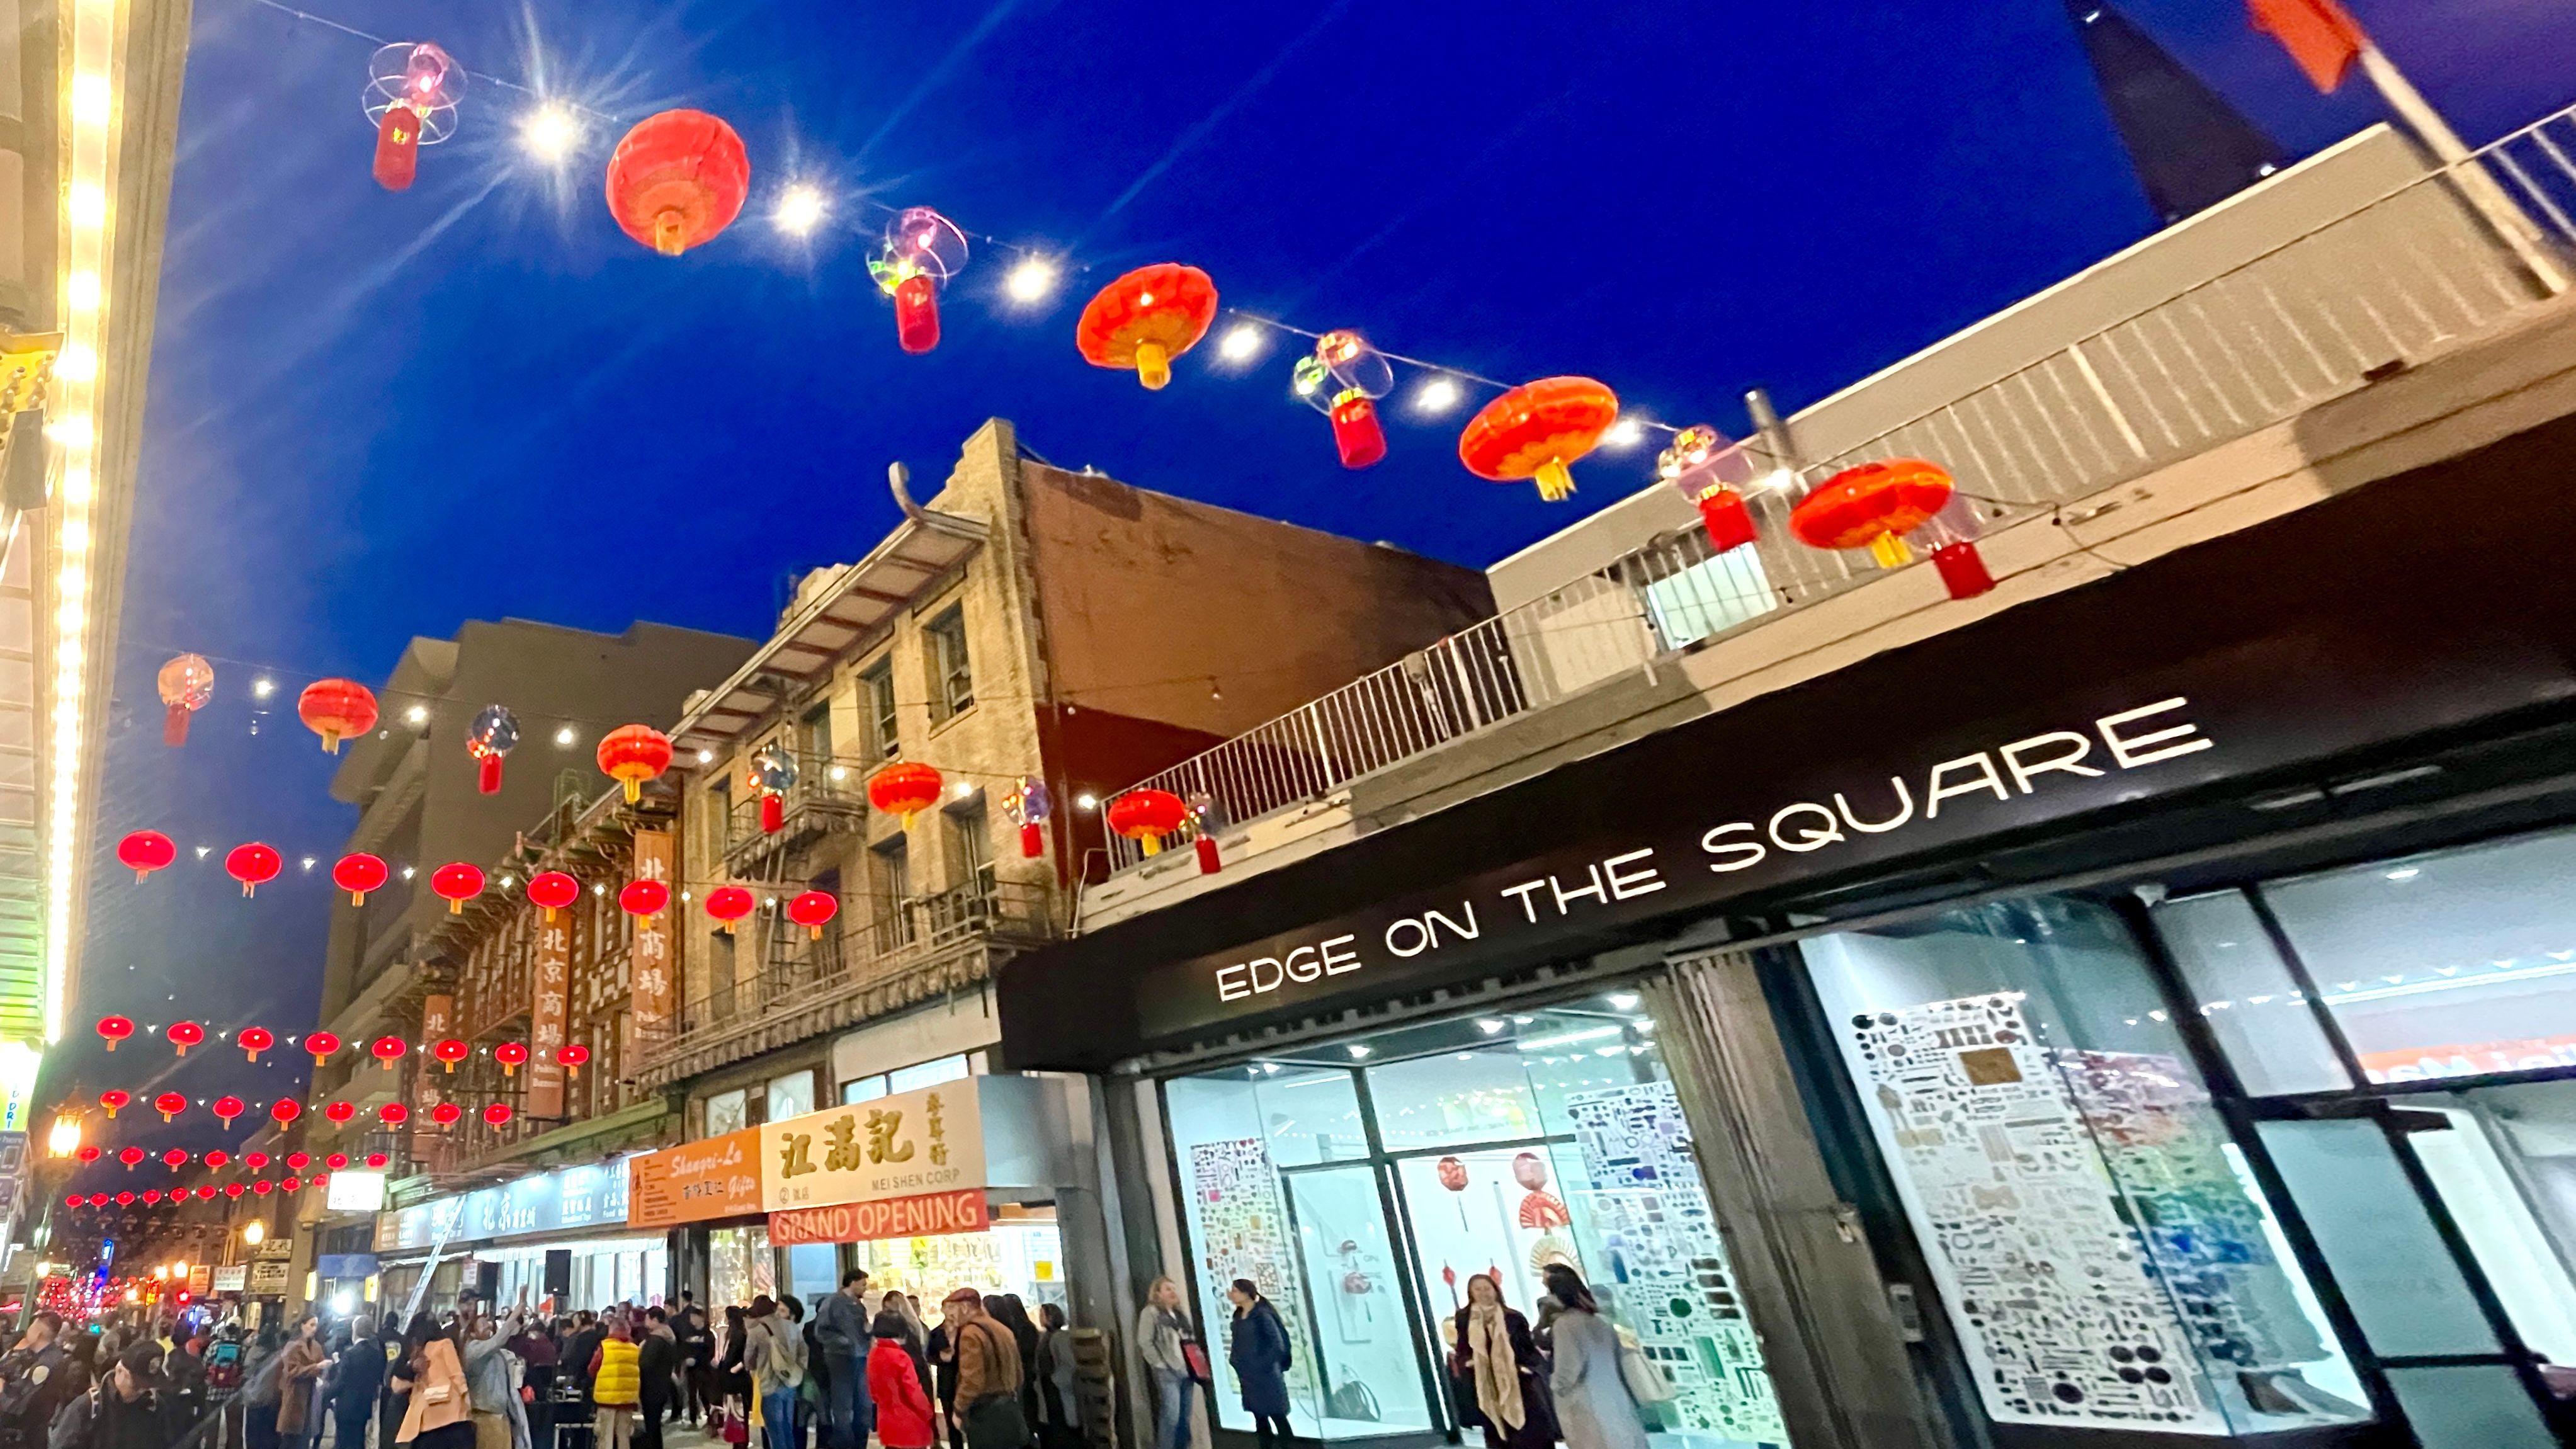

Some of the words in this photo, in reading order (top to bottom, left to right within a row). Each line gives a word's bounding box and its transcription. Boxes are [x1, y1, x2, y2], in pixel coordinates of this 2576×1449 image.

[1216, 935, 1361, 1002] EDGE
[1386, 902, 1478, 957] ON
[1501, 849, 1666, 923] THE
[1702, 696, 2213, 872] SQUARE
[637, 857, 669, 997] 北商場
[537, 928, 568, 1047] 北京商場
[669, 1140, 743, 1178] Shangri-La
[871, 1179, 890, 1191] MEI
[893, 1174, 924, 1188] SHEN
[926, 1168, 960, 1185] CORP
[728, 1175, 756, 1200] Gifts
[775, 1208, 851, 1240] GRAND
[857, 1192, 978, 1236] OPENING
